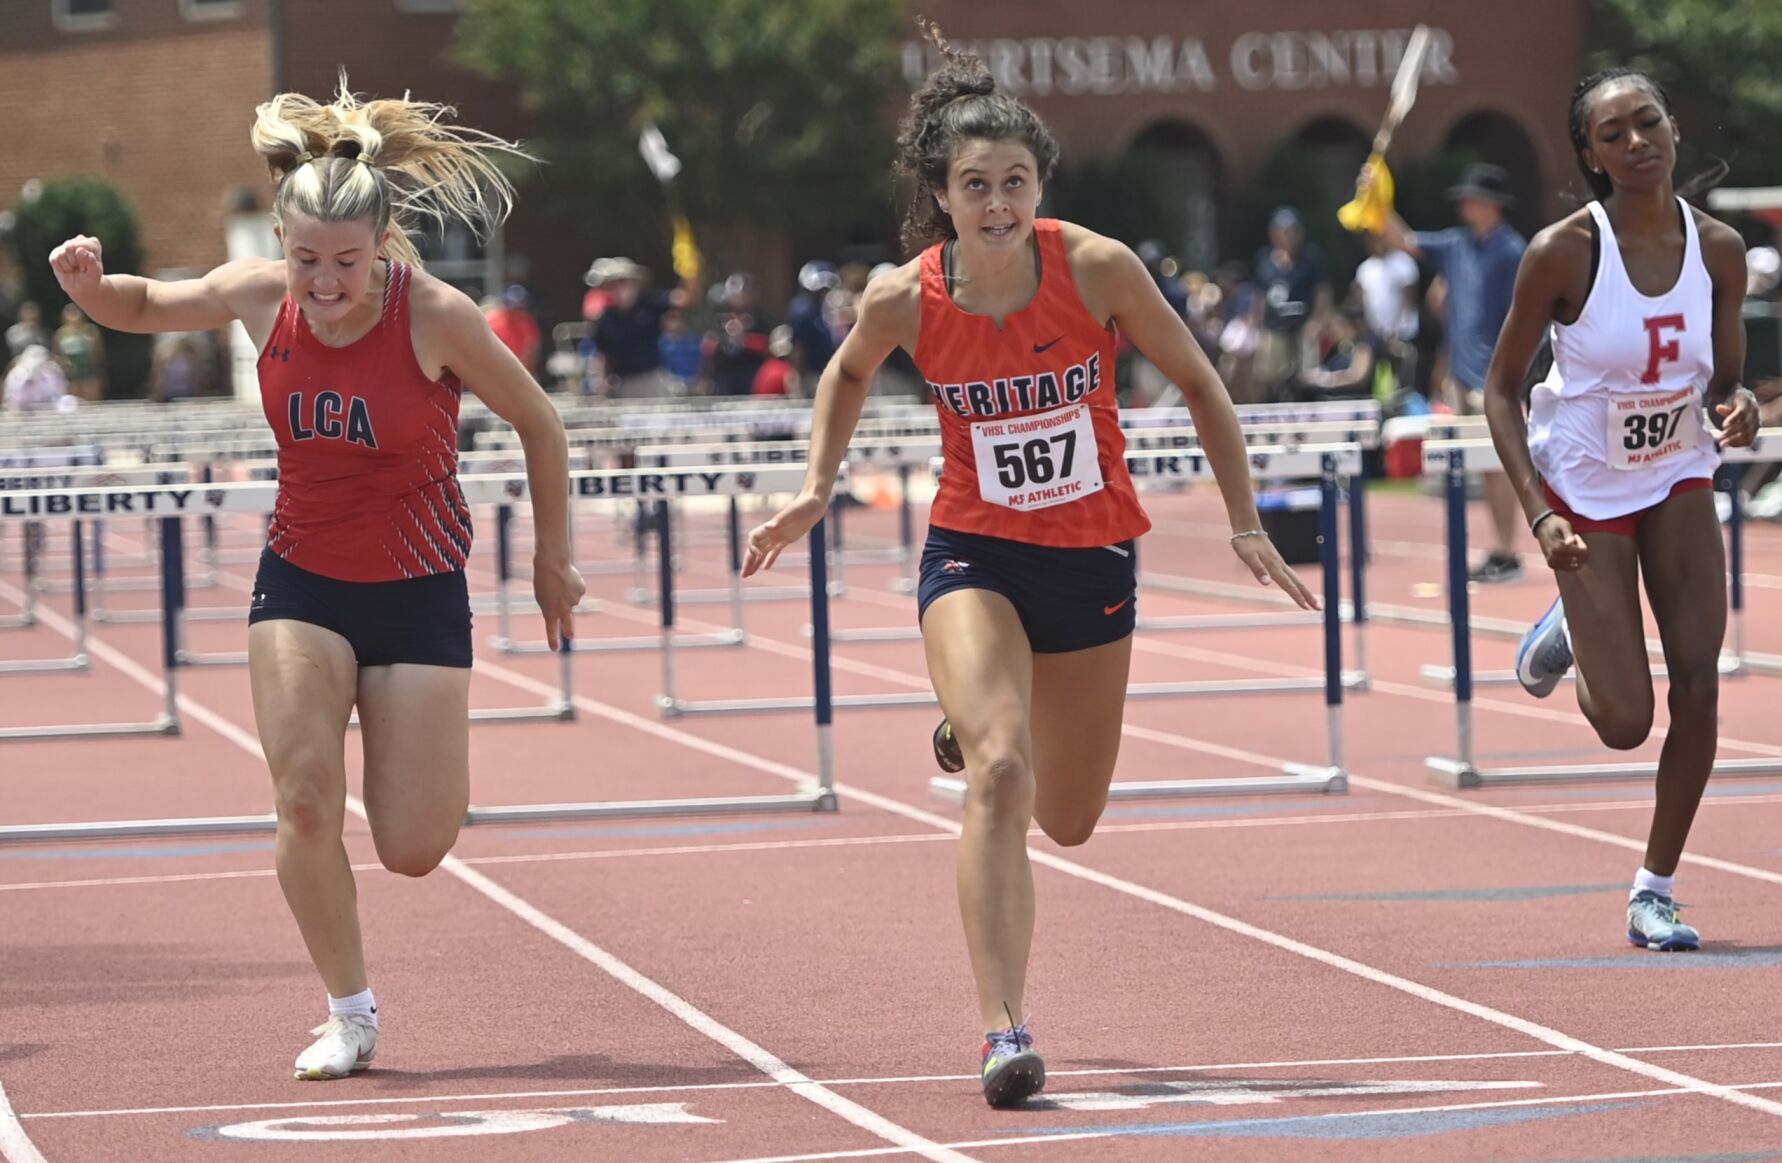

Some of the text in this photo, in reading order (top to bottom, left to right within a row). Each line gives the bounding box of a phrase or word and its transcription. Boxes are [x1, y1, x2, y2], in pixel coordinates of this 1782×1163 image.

[1230, 29, 1458, 92] CENTER
[1641, 313, 1687, 385] F
[288, 391, 379, 449] LCA
[982, 409, 1081, 438] VHSL CHAMPIONSHIPS
[1624, 403, 1688, 450] 397
[993, 430, 1077, 489] 567
[3, 490, 194, 516] LIBERTY
[1028, 481, 1082, 503] ATHLETIC
